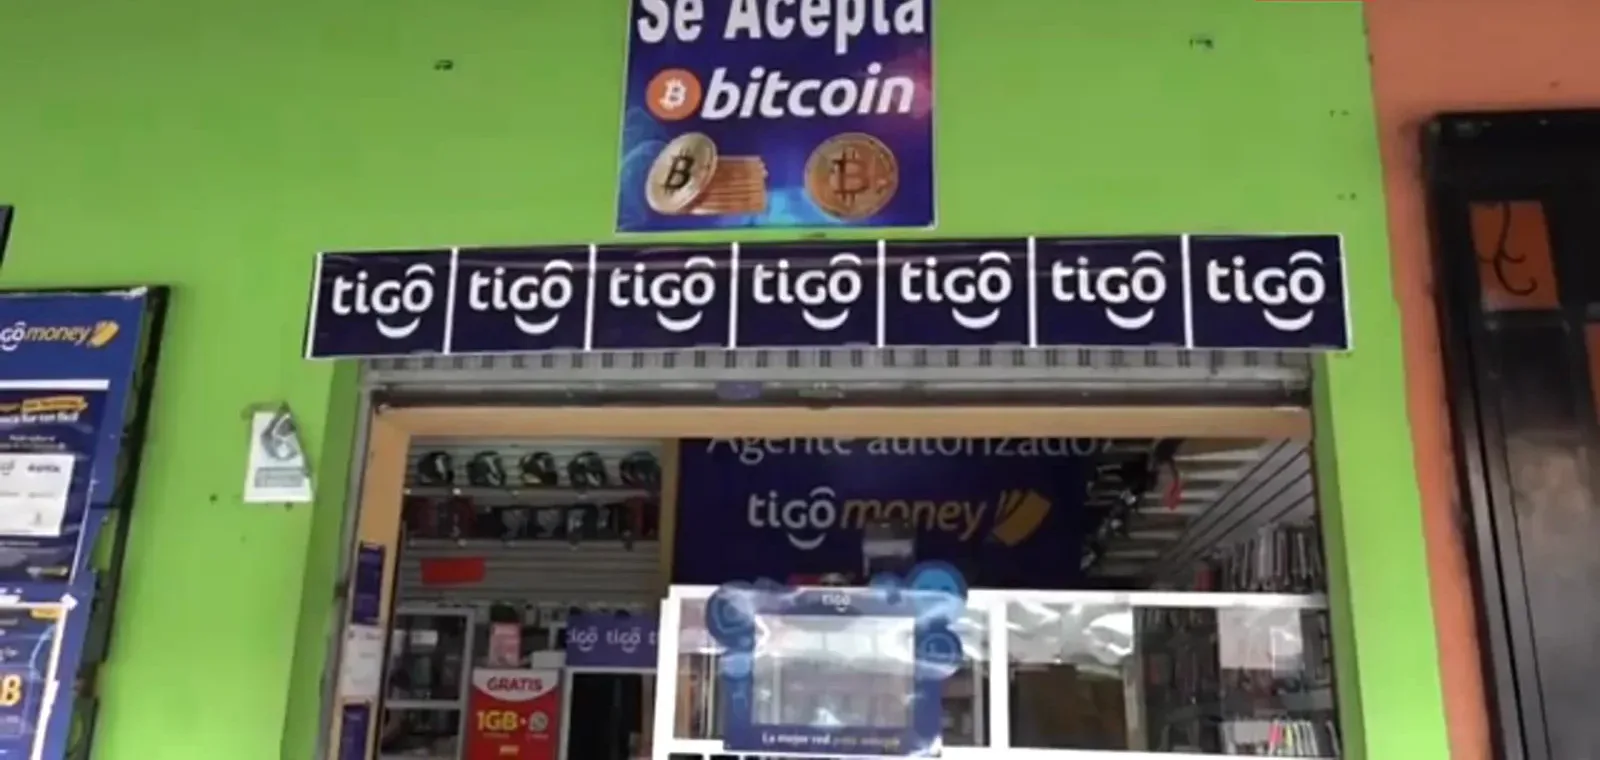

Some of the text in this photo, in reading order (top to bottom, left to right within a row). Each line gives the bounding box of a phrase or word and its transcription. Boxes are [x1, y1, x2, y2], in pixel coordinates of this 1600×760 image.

[637, 0, 926, 54] Se Acepta
[701, 63, 915, 120] bitcoin
[486, 676, 543, 692] GRATIS
[476, 709, 519, 731] 1GB
